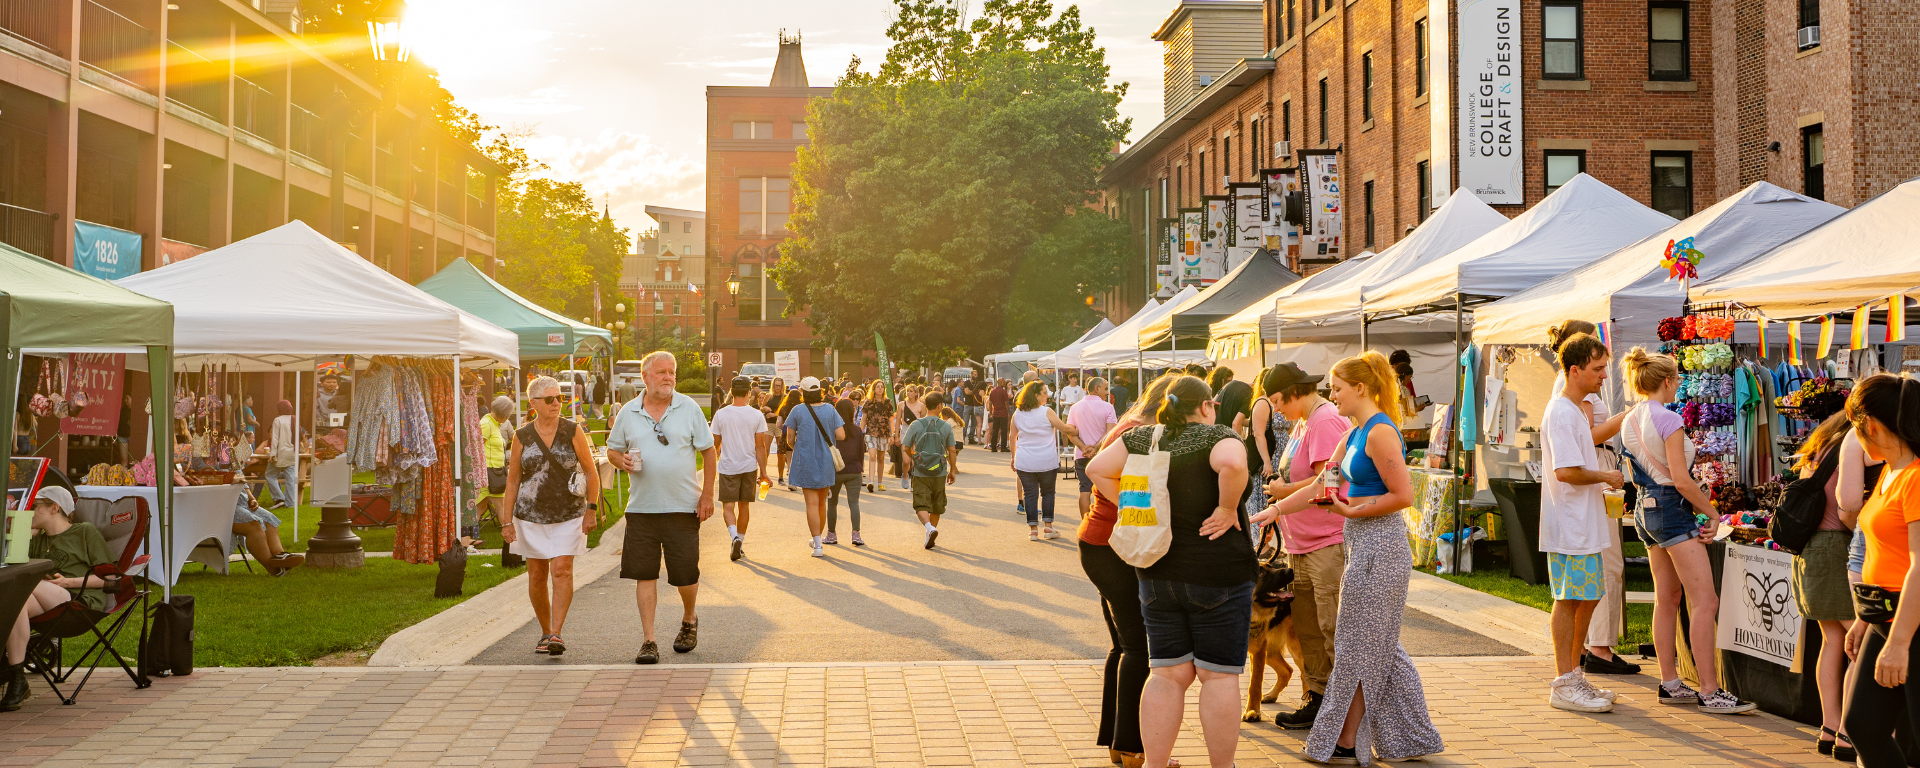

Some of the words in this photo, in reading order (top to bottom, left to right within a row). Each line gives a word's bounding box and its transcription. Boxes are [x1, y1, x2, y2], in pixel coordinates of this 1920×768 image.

[1496, 7, 1511, 77] DESIGN
[1486, 58, 1493, 69] OF
[1499, 82, 1511, 94] &
[1480, 72, 1494, 157] COLLEGE
[1498, 98, 1512, 157] CRAFT
[1300, 160, 1308, 182] PRACTICE
[95, 239, 119, 265] 1826
